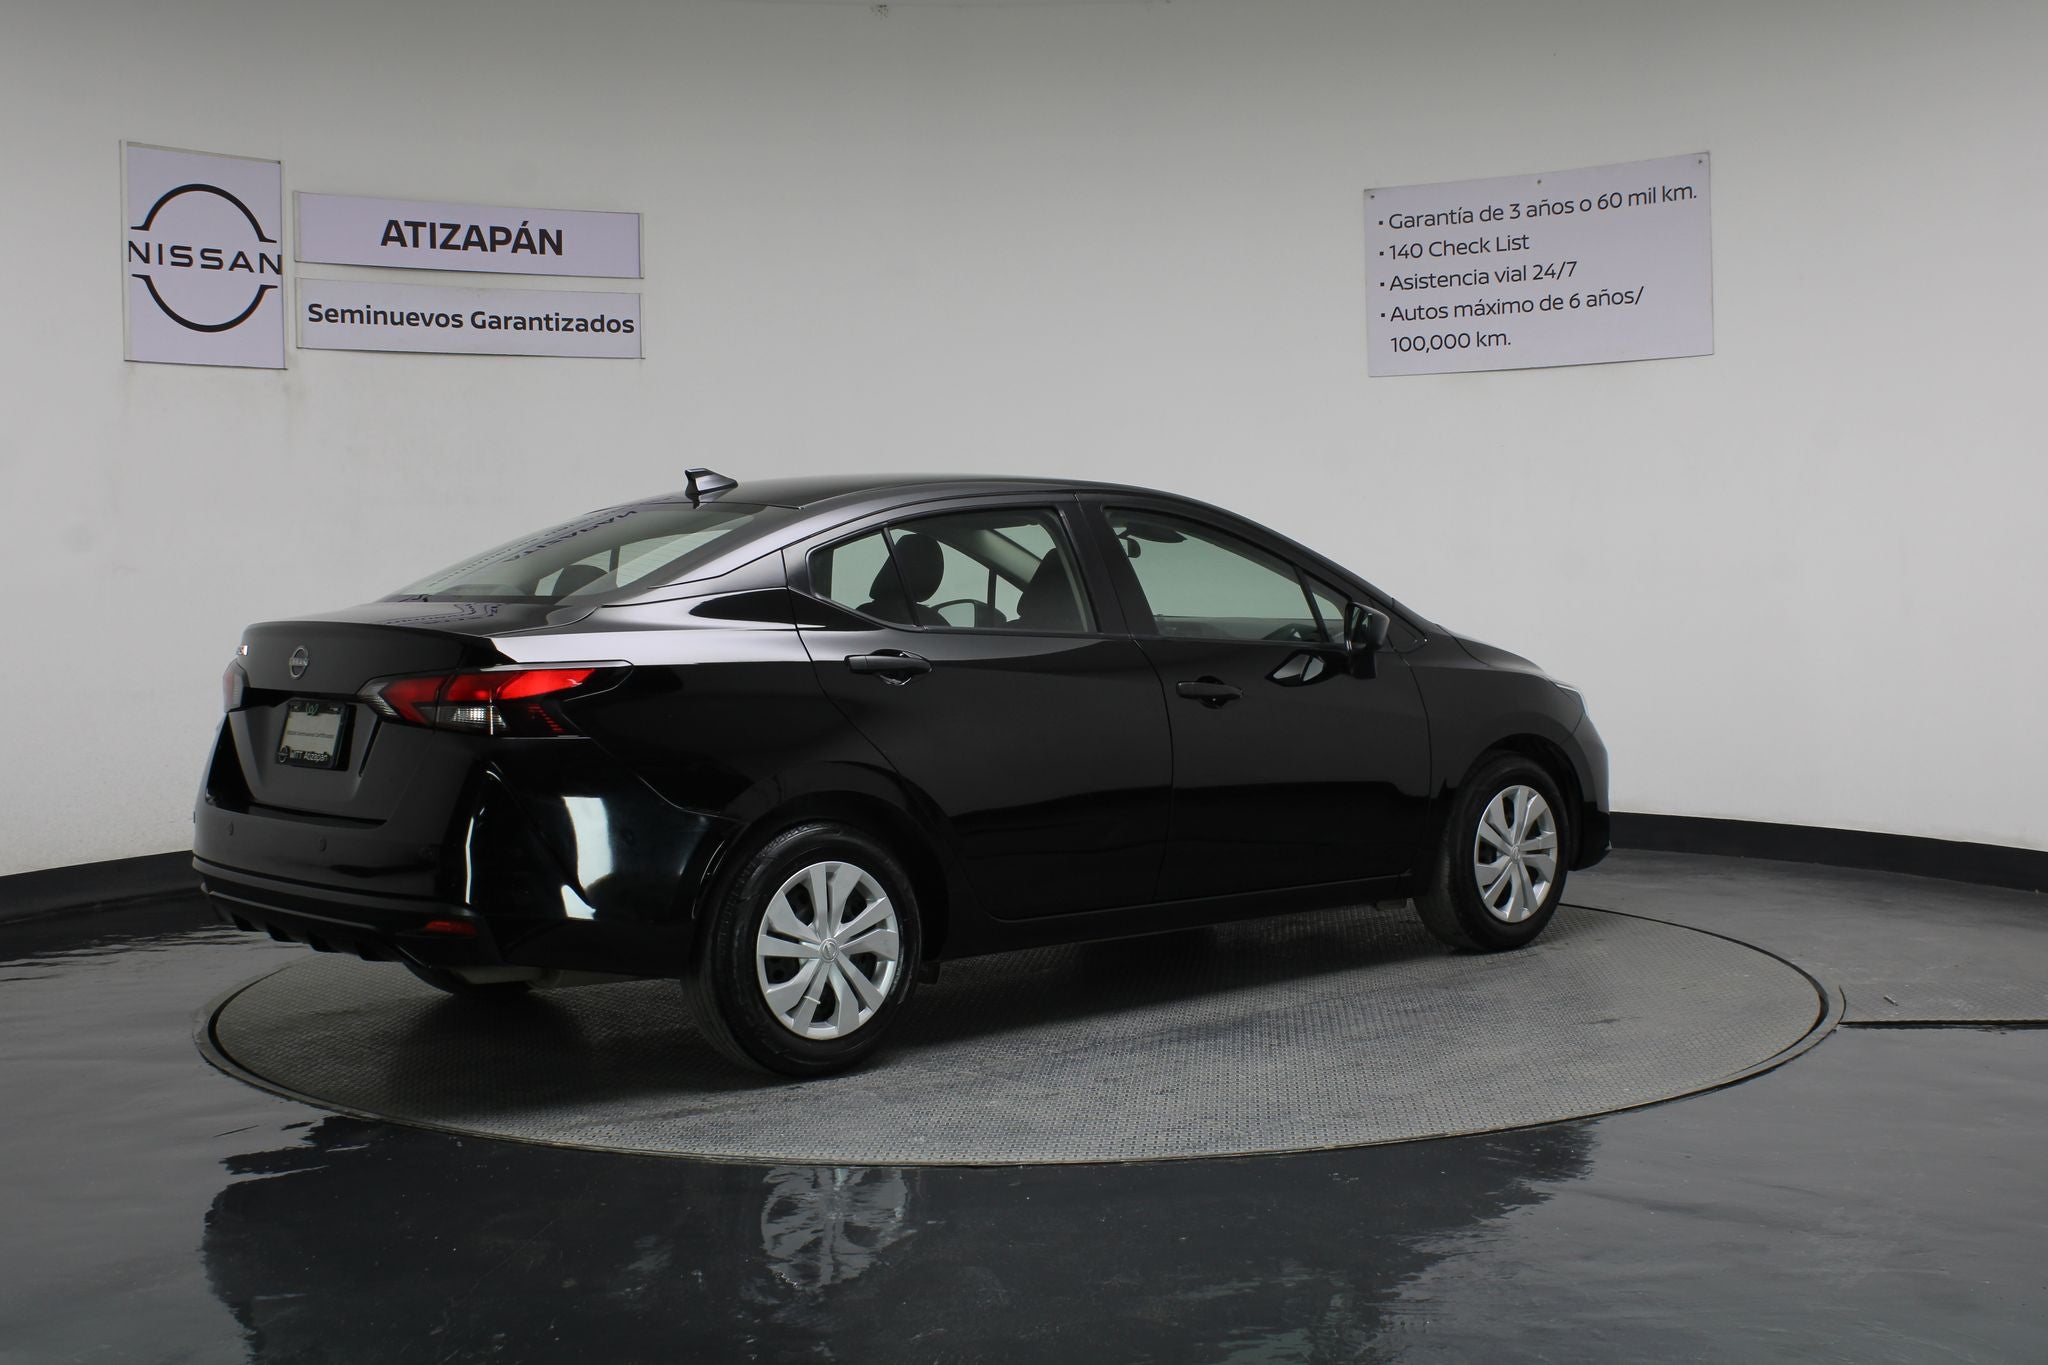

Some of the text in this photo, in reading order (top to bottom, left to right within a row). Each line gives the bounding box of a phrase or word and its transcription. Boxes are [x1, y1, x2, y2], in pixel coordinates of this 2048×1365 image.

[1388, 185, 1698, 230] Garantía de 3 años o 60 mil km.
[380, 218, 563, 257] ATIZAPÁN
[1388, 234, 1530, 260] 140 Check List
[127, 240, 283, 276] NISSAN
[1389, 260, 1578, 292] Asistencia vial 24/7
[307, 302, 635, 335] Seminuevos Garantizados
[1389, 285, 1645, 322] Autos máximo de 6 años/
[1390, 331, 1512, 354] 100,000 km.
